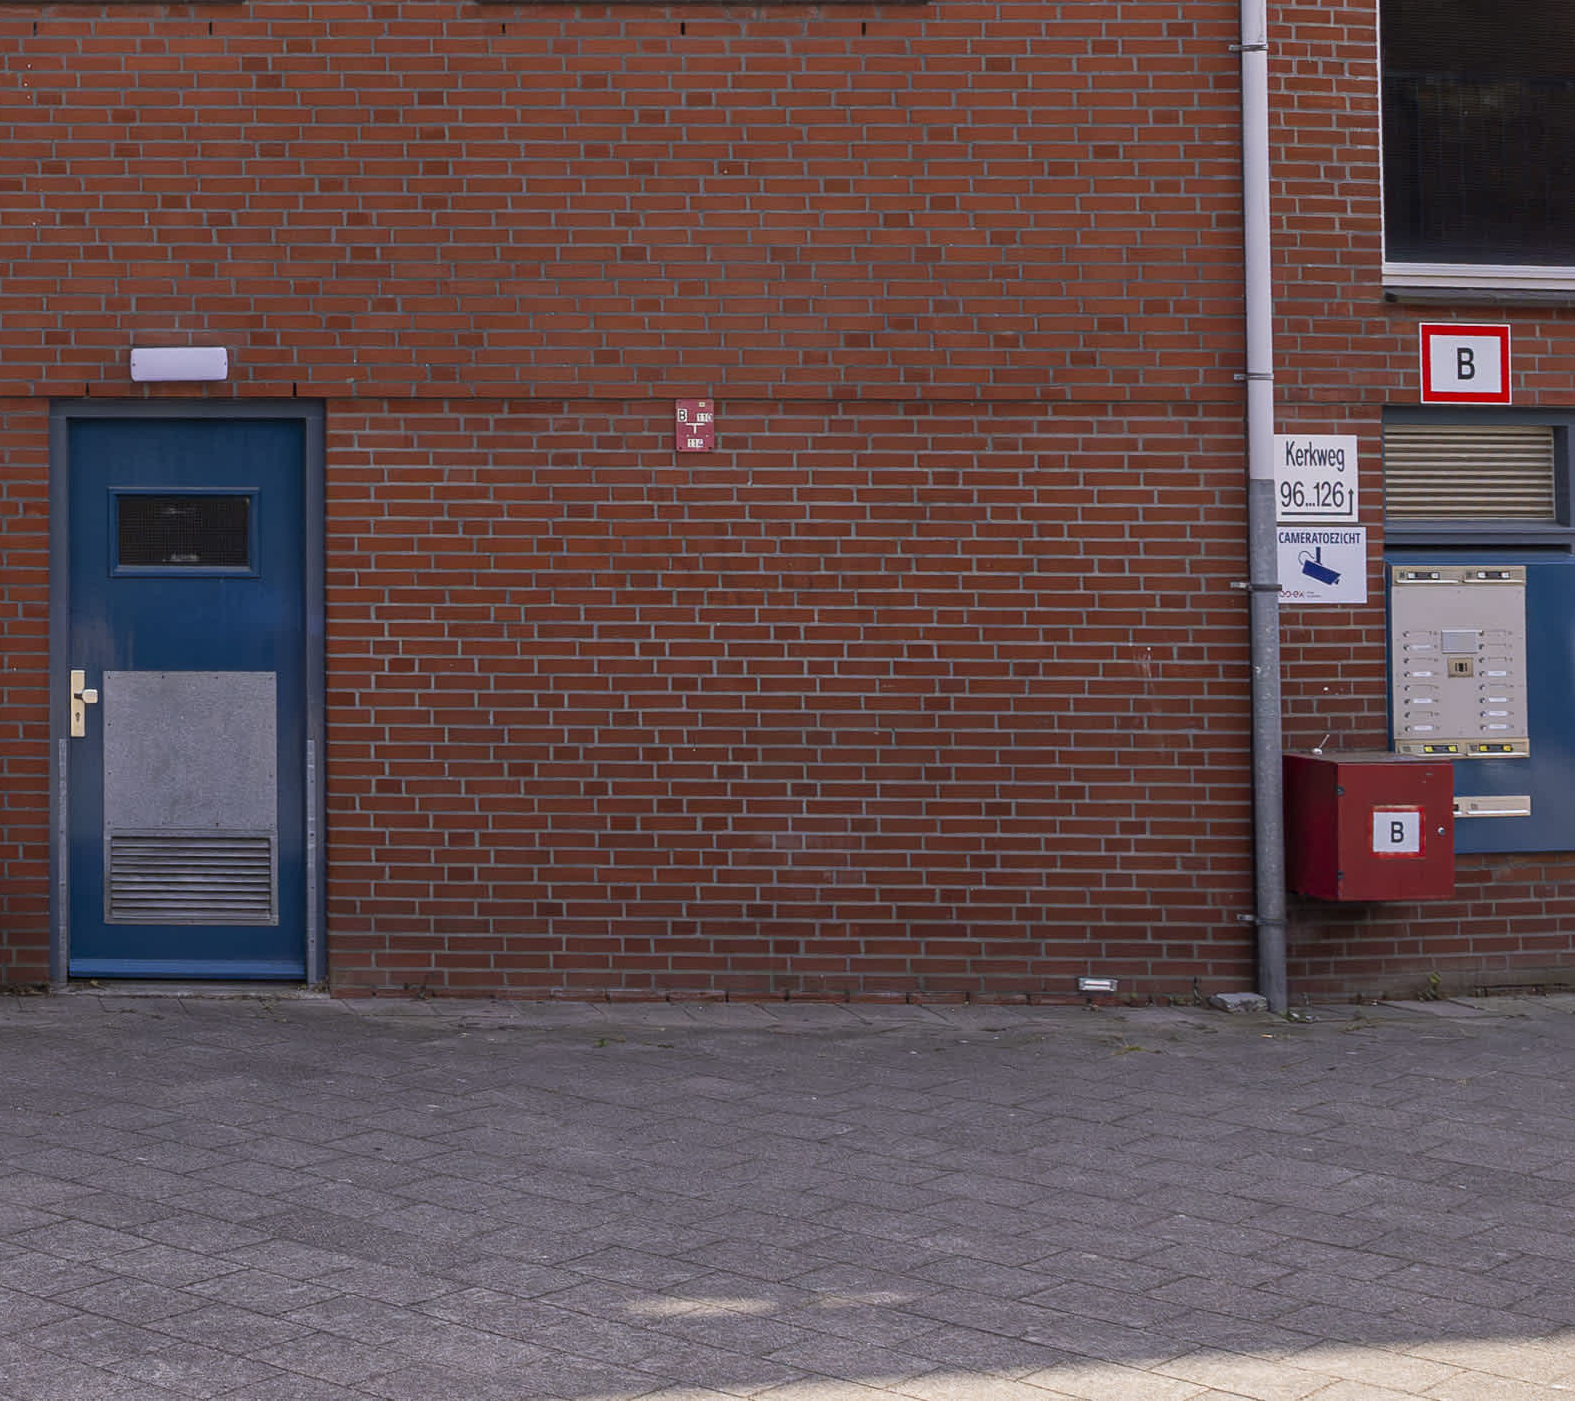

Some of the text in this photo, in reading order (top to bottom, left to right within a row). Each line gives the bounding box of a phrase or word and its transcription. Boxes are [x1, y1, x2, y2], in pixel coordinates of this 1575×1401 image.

[1457, 347, 1475, 380] B
[679, 410, 686, 420] B
[1286, 441, 1345, 472] Kerkweg
[1278, 531, 1361, 544] CAMERATOEZICHT
